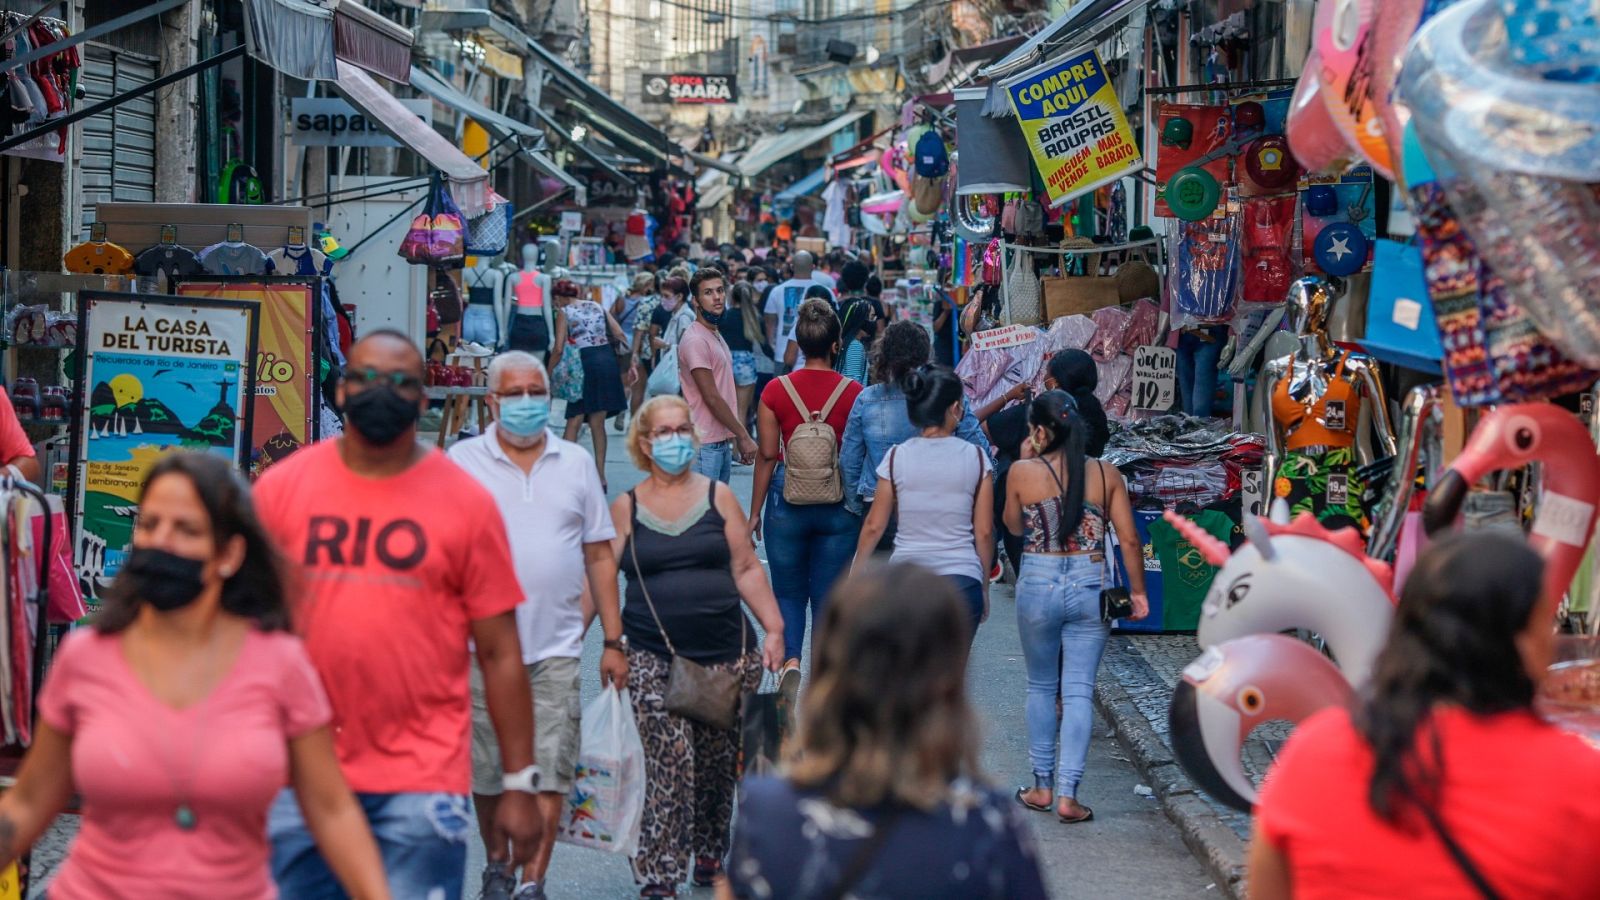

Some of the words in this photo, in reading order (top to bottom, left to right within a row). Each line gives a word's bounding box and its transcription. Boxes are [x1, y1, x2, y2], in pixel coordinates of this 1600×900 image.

[669, 83, 731, 99] SAARA
[1018, 59, 1097, 105] COMPRE
[1041, 84, 1088, 118] AQUI
[1037, 105, 1110, 144] BRASIL
[1044, 118, 1116, 159] ROUPAS
[1096, 132, 1122, 153] MAIS
[1058, 163, 1089, 193] VENDE
[1096, 143, 1134, 169] BARATO
[124, 316, 149, 332] LA
[155, 318, 212, 336] CASA
[102, 333, 139, 350] DEL
[146, 335, 231, 356] TURISTA
[96, 353, 141, 364] Recuerdos
[143, 355, 155, 366] de
[172, 358, 185, 368] de
[187, 360, 218, 371] Janeiro
[89, 462, 101, 470] Rio
[102, 463, 112, 471] de
[115, 463, 140, 472] Janeiro
[303, 514, 428, 573] RIO
